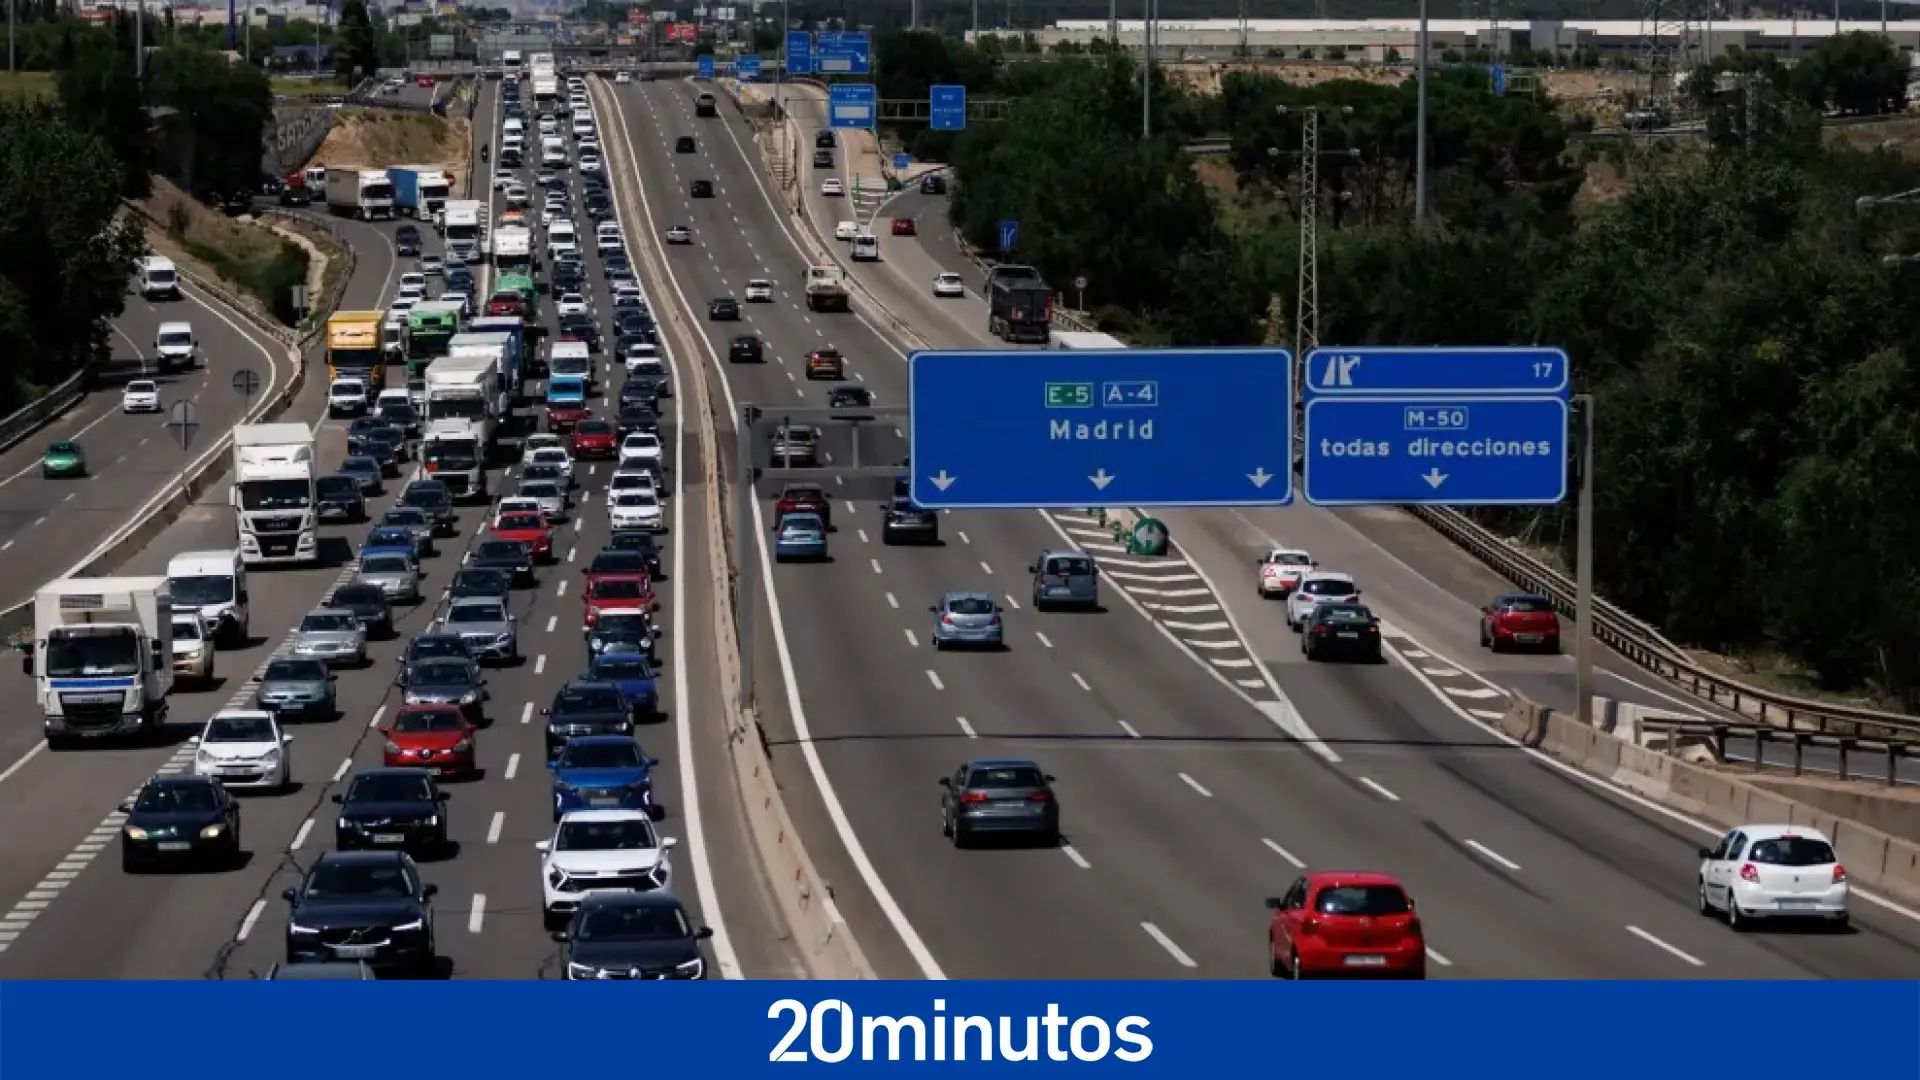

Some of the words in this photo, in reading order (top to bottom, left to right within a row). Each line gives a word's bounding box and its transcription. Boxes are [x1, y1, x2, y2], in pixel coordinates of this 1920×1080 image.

[1533, 362, 1553, 378] 17
[1049, 385, 1089, 403] E-5
[1107, 384, 1153, 402] A-4
[1407, 410, 1464, 426] M-50
[1050, 418, 1153, 440] Madrid
[1320, 437, 1390, 457] todas
[1407, 436, 1551, 457] direcciones
